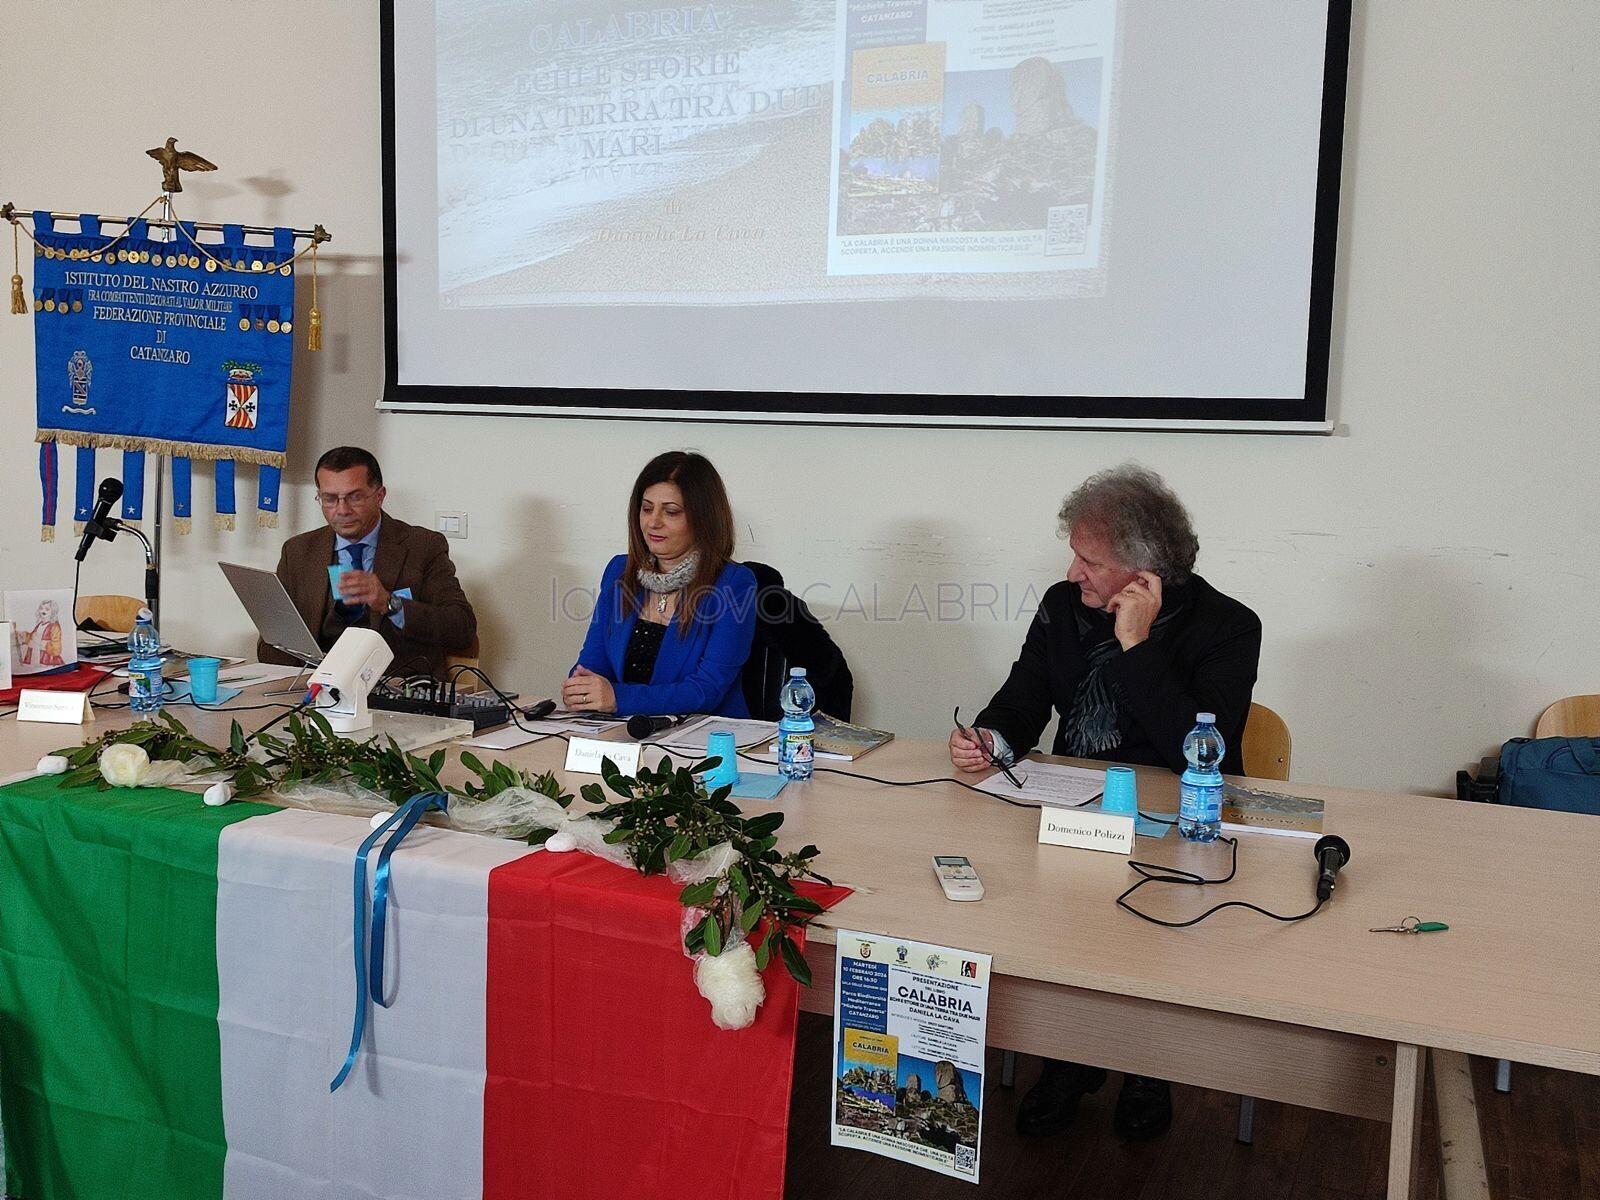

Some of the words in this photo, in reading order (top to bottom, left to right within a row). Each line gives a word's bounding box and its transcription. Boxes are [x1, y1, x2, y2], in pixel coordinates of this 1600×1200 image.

[528, 4, 723, 54] CALABRIA
[514, 68, 588, 95] ECHI
[596, 63, 612, 86] E
[620, 52, 742, 83] STORIE
[866, 69, 929, 84] CALABRIA
[449, 117, 481, 139] DI
[489, 111, 548, 135] UNA
[557, 98, 662, 129] TERRA
[670, 93, 735, 119] TRA
[747, 84, 825, 115] DUE
[581, 133, 662, 160] MARI
[64, 271, 121, 288] ISTITUTO
[123, 274, 149, 290] DEL
[151, 277, 199, 294] NASTRO
[201, 281, 259, 300] AZZURRO
[88, 289, 100, 301] FRA
[183, 296, 205, 310] VALOR
[93, 305, 162, 324] FEDERAZIONE
[163, 311, 227, 331] PROVINCIALE
[156, 330, 166, 344] DI
[130, 346, 191, 364] CATANZARO
[1047, 822, 1092, 836] Domenico
[1094, 828, 1126, 841] Polizzi
[912, 976, 960, 991] PRESENTAZIONE
[897, 985, 973, 1014] CALABRIA
[909, 1007, 934, 1019] DANIELA
[934, 1012, 942, 1020] LA
[943, 1015, 960, 1025] CAVA
[852, 1041, 890, 1054] CALABRIA
